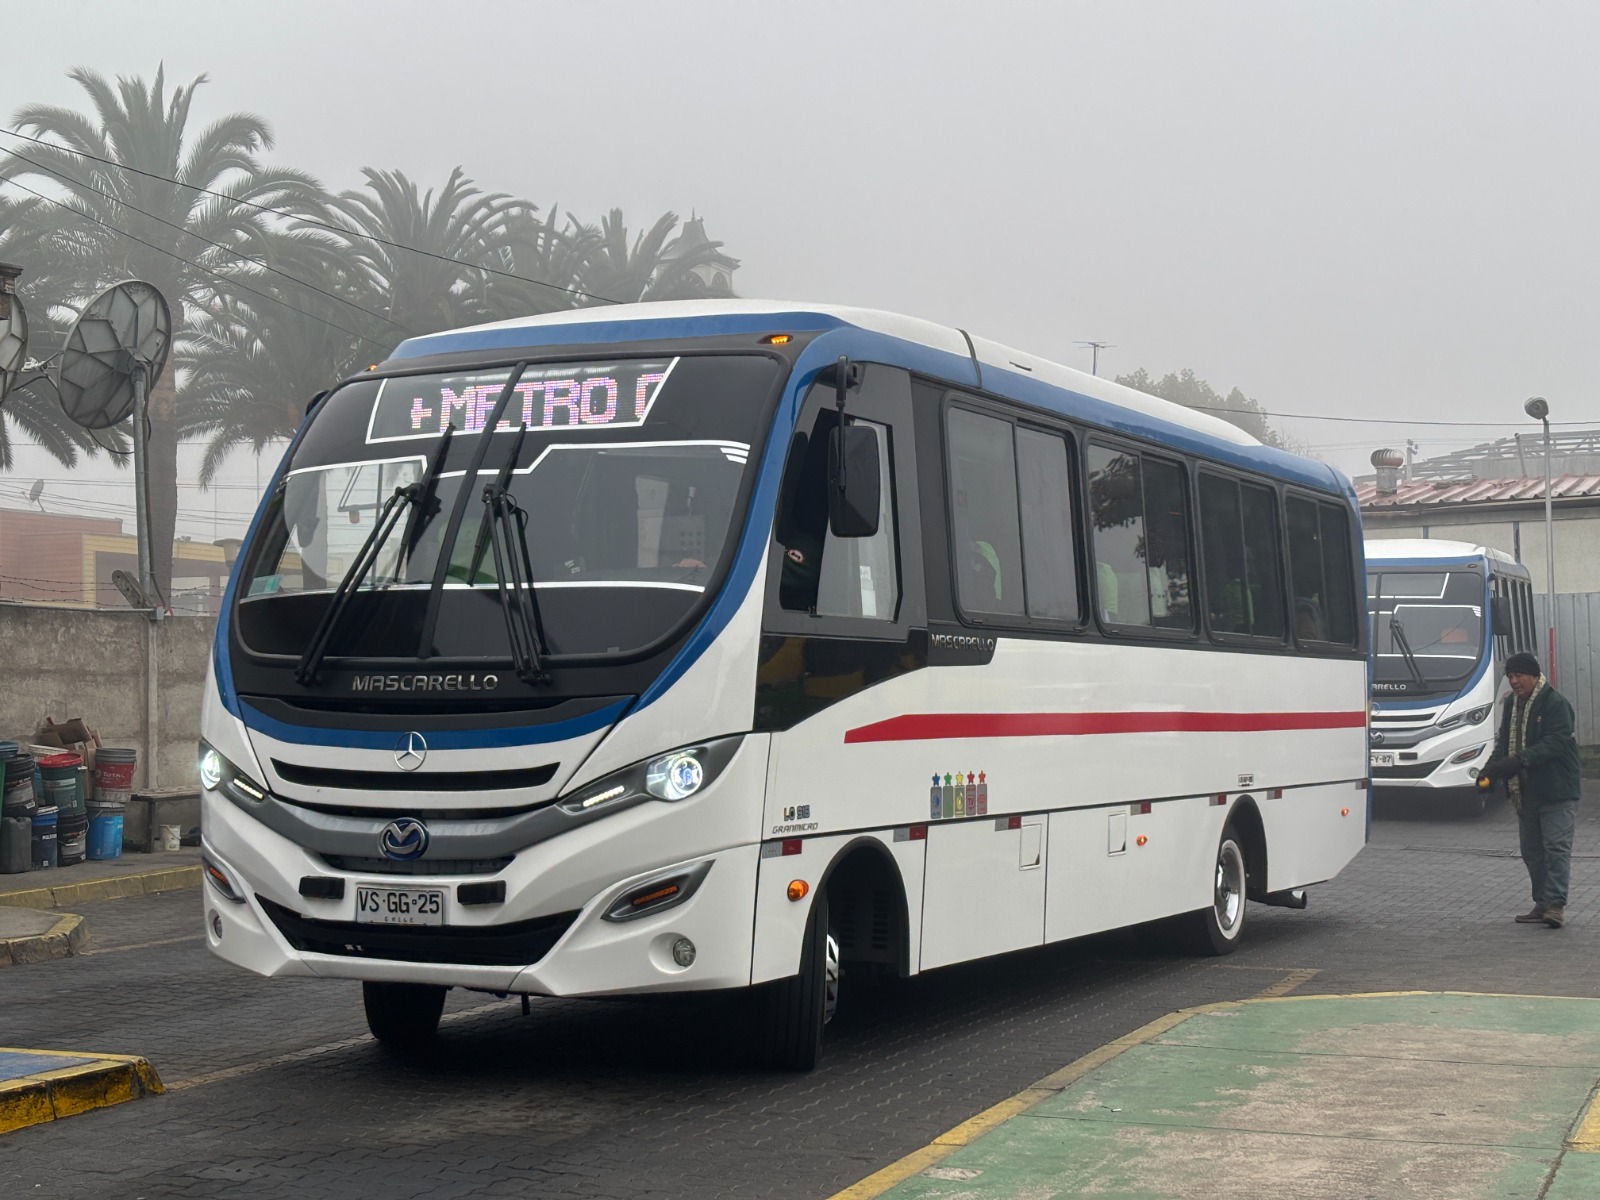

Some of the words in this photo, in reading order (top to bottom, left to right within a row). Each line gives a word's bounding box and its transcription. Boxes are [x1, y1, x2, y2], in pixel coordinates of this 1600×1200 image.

[931, 633, 994, 651] MASCARELLO
[352, 674, 499, 691] MASCARELLO
[772, 822, 819, 834] GRANMICRO
